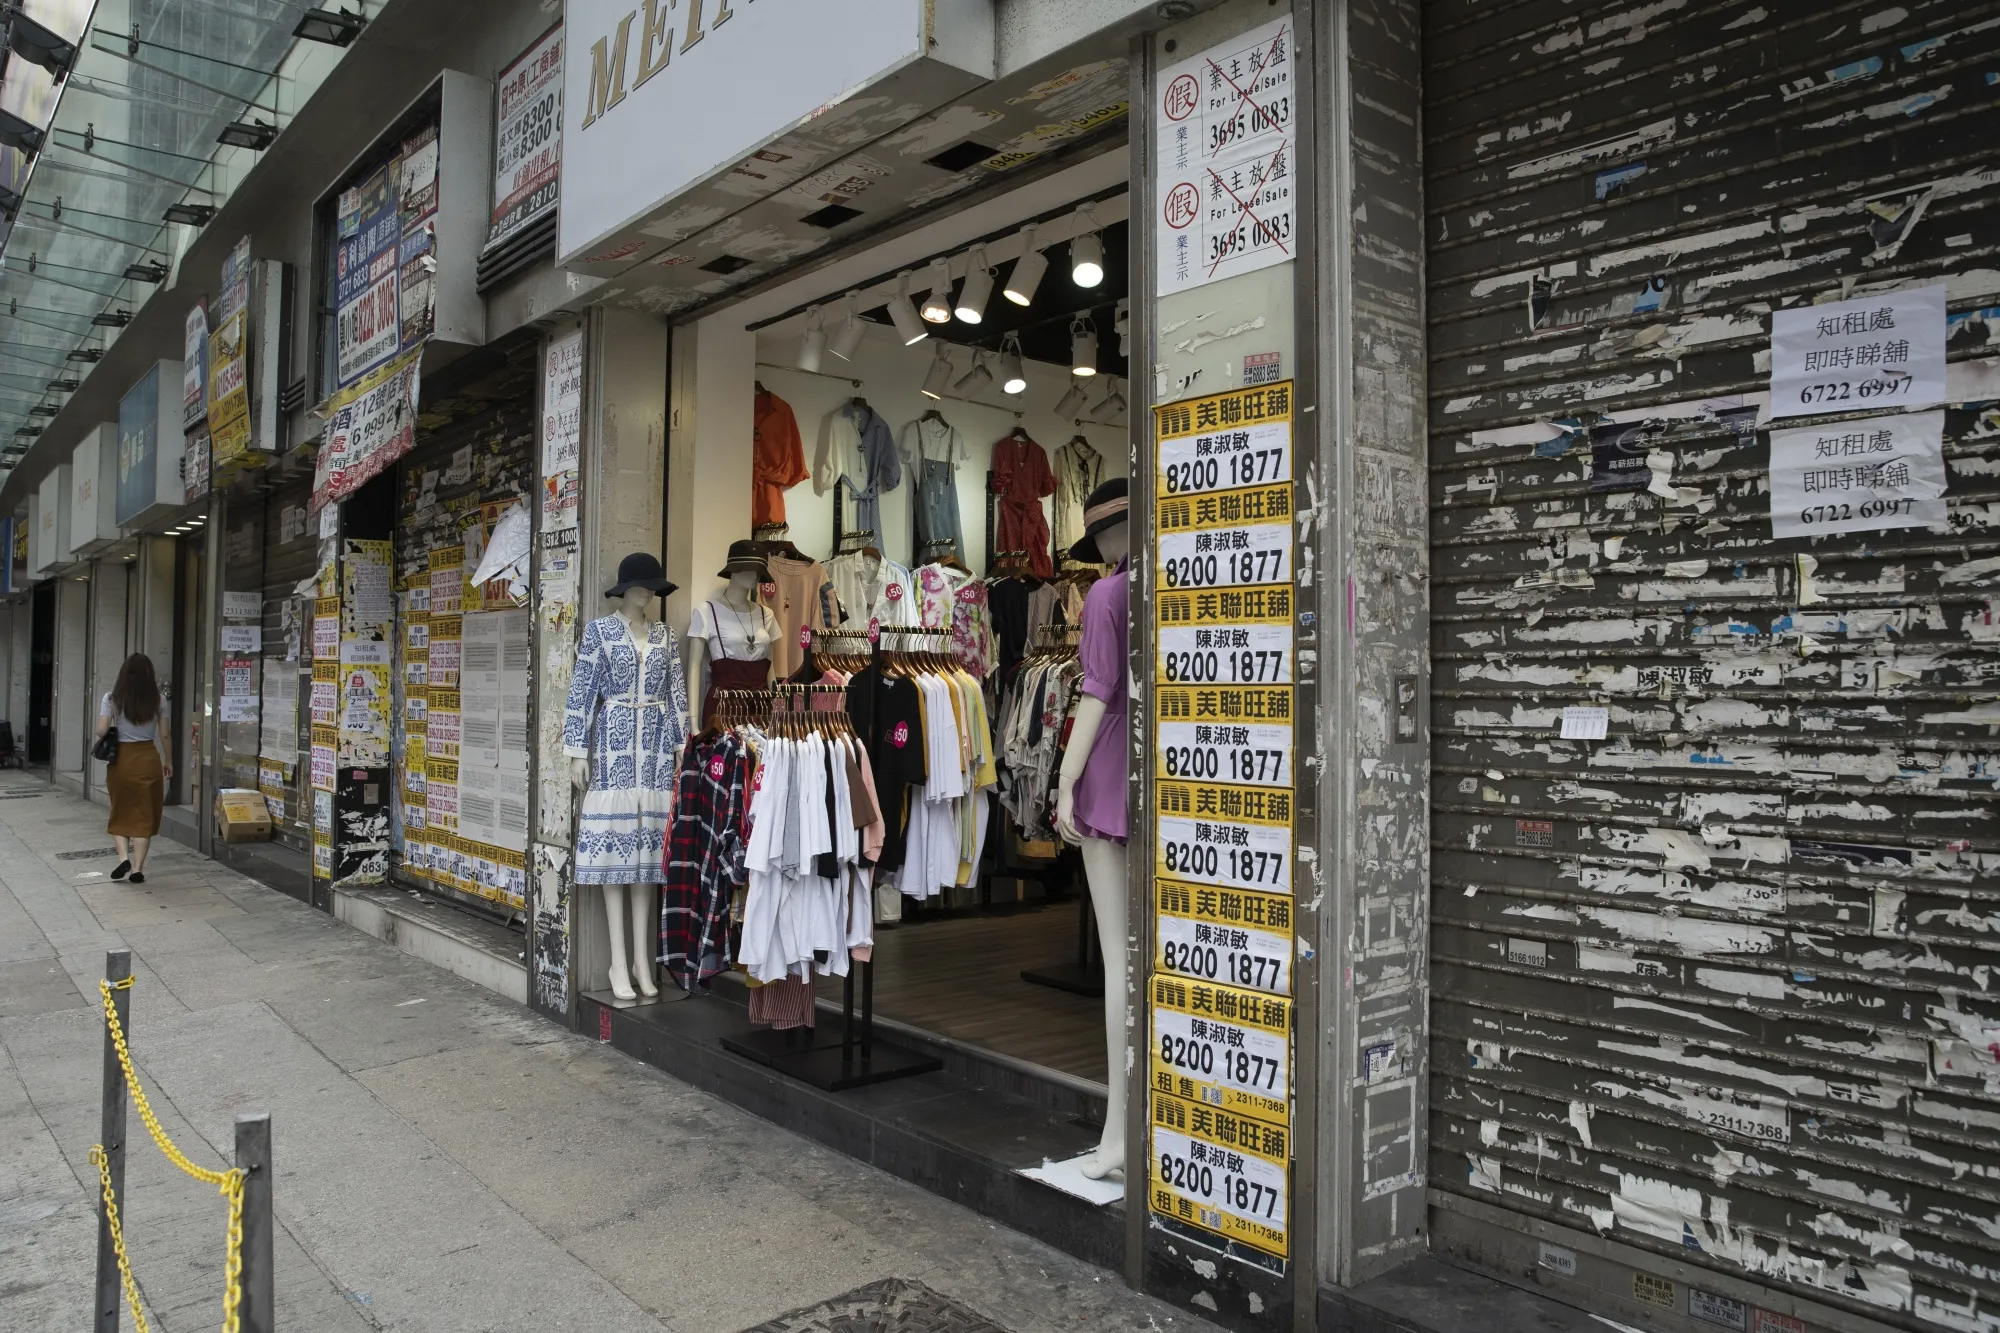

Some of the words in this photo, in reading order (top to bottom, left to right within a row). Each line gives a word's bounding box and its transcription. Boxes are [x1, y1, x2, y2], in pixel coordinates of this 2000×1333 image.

[1209, 38, 1286, 92] 業主放盤
[1168, 81, 1195, 116] 假
[1210, 98, 1226, 111] For
[1231, 72, 1287, 105] Lease/Sale
[522, 93, 554, 135] 8300
[1210, 114, 1245, 149] 3695
[1252, 97, 1289, 133] 0883
[520, 118, 551, 159] 8300
[1176, 126, 1188, 171] 業主示
[1210, 152, 1287, 202] 業主放盤
[1168, 188, 1195, 223] 假
[1210, 209, 1226, 222] For
[1231, 188, 1288, 215] Lease/Sale
[1210, 227, 1246, 260] 3695
[1252, 213, 1290, 248] 0883
[1176, 235, 1189, 281] 業主示
[1816, 307, 1895, 338] 知租處
[1805, 340, 1910, 372] 即時睇舖
[1800, 382, 1850, 404] 6722
[1858, 376, 1913, 398] 6997
[1196, 387, 1289, 429] 美聯旺舖
[1196, 432, 1249, 457] 陳淑敏
[1815, 430, 1893, 459] 知租處
[1167, 457, 1218, 494] 8200
[1230, 448, 1282, 485] 1877
[1803, 464, 1909, 494] 即時睇舖
[1196, 488, 1289, 524] 美聯旺舖
[1801, 503, 1852, 524] 6722
[1859, 497, 1917, 520] 6997
[1196, 530, 1249, 553] 陳淑敏
[1166, 555, 1217, 588] 8200
[1229, 549, 1282, 584] 1877
[1196, 589, 1289, 619] 美聯旺舖
[1196, 629, 1249, 649] 陳淑敏
[1166, 651, 1218, 682] 8200
[1230, 650, 1282, 682] 1877
[1196, 690, 1289, 718] 美聯旺舖
[1196, 726, 1249, 746] 陳淑敏
[1166, 746, 1218, 778] 8200
[1230, 749, 1282, 782] 1877
[1196, 788, 1289, 821] 美聯旺舖
[1196, 823, 1249, 847] 陳淑敏
[1166, 842, 1218, 876] 8200
[1230, 849, 1282, 884] 1877
[1196, 889, 1289, 928] 美聯旺舖
[1196, 924, 1248, 951] 陳淑敏
[1165, 941, 1217, 978] 8200
[1229, 952, 1281, 990] 1877
[1509, 951, 1527, 964] 5166
[1527, 953, 1545, 966] 1012
[1192, 985, 1285, 1028] 美聯旺舖
[1192, 1019, 1245, 1049] 陳淑敏
[1161, 1034, 1213, 1075] 8200
[1225, 1049, 1278, 1090] 1877
[1237, 1092, 1285, 1114] 2311-7368
[1191, 1107, 1285, 1159] 美聯旺舖
[1709, 1113, 1783, 1141] 2311-7368
[1191, 1140, 1244, 1176] 陳淑敏
[1161, 1153, 1212, 1198] 8200
[1225, 1174, 1277, 1219] 1877
[1235, 1218, 1283, 1244] 2311-7368
[1702, 1304, 1720, 1316] 9633
[1721, 1310, 1740, 1322] 7802
